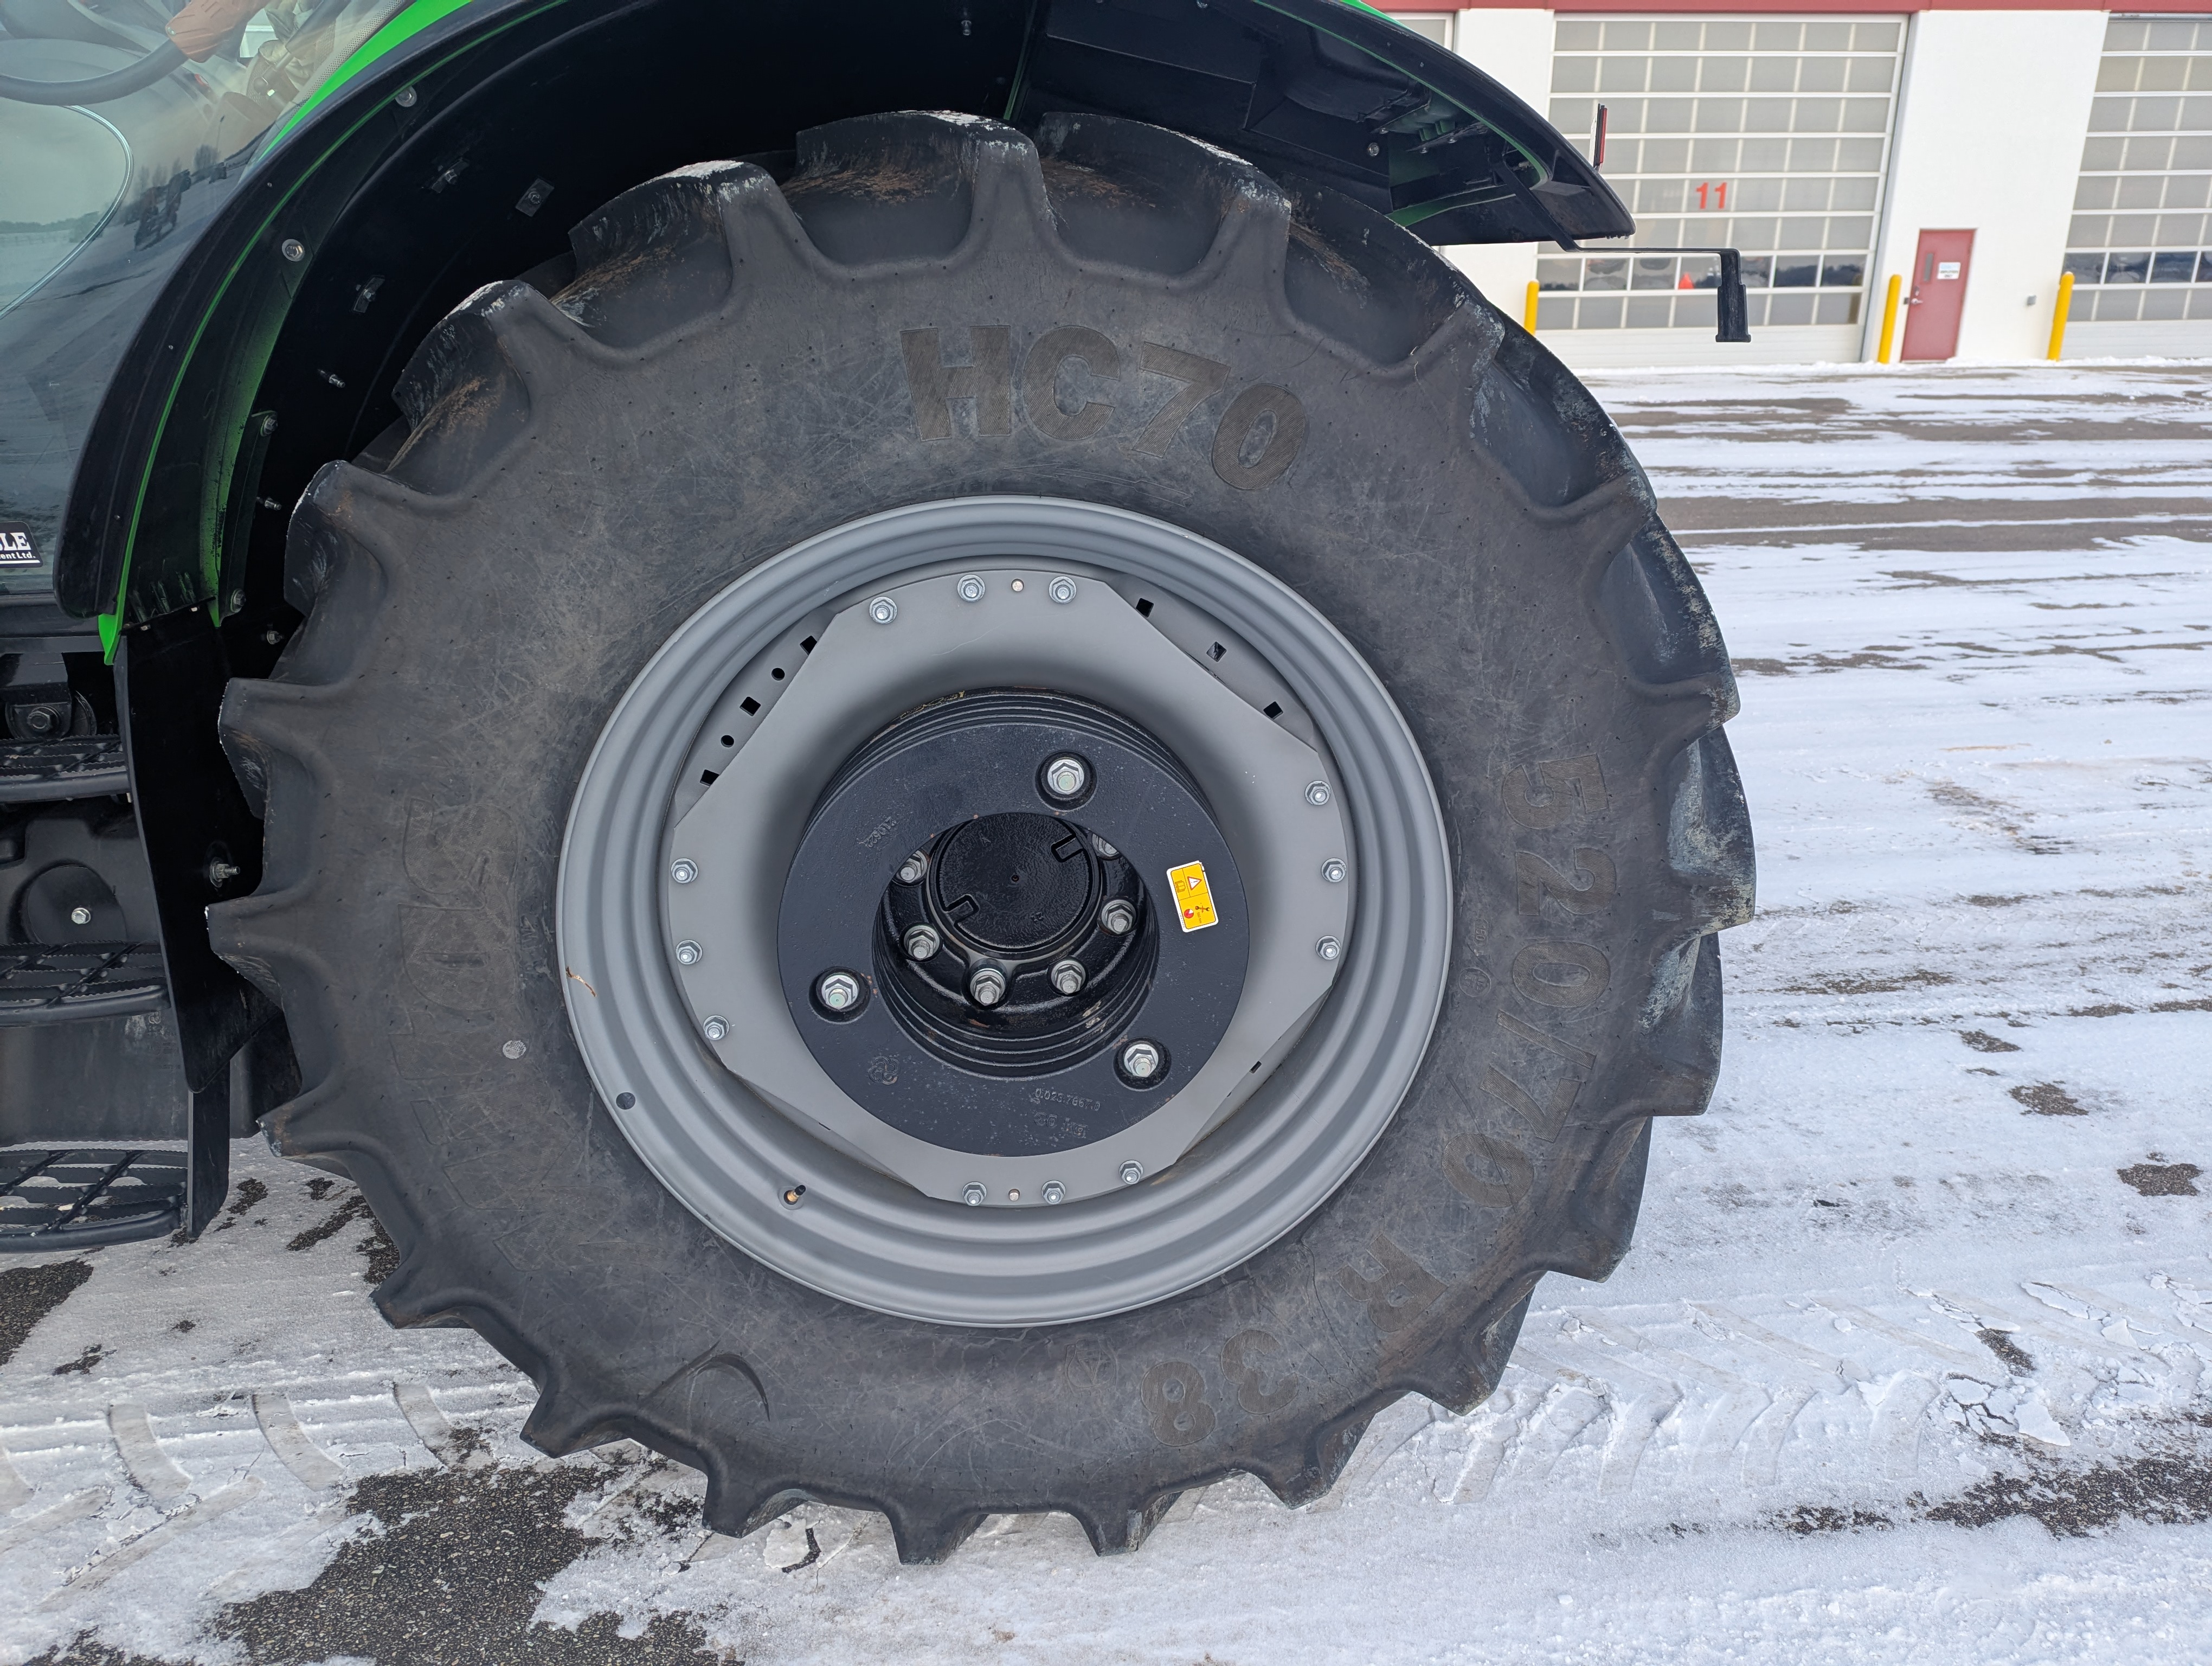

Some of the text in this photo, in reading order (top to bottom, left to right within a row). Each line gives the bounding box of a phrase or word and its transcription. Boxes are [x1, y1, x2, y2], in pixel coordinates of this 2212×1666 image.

[1695, 182, 1728, 209] 11
[899, 325, 1306, 491] HC70
[0, 532, 31, 550] LE
[1475, 925, 1487, 941] 150
[1140, 753, 1617, 1447] 520/70 R 38
